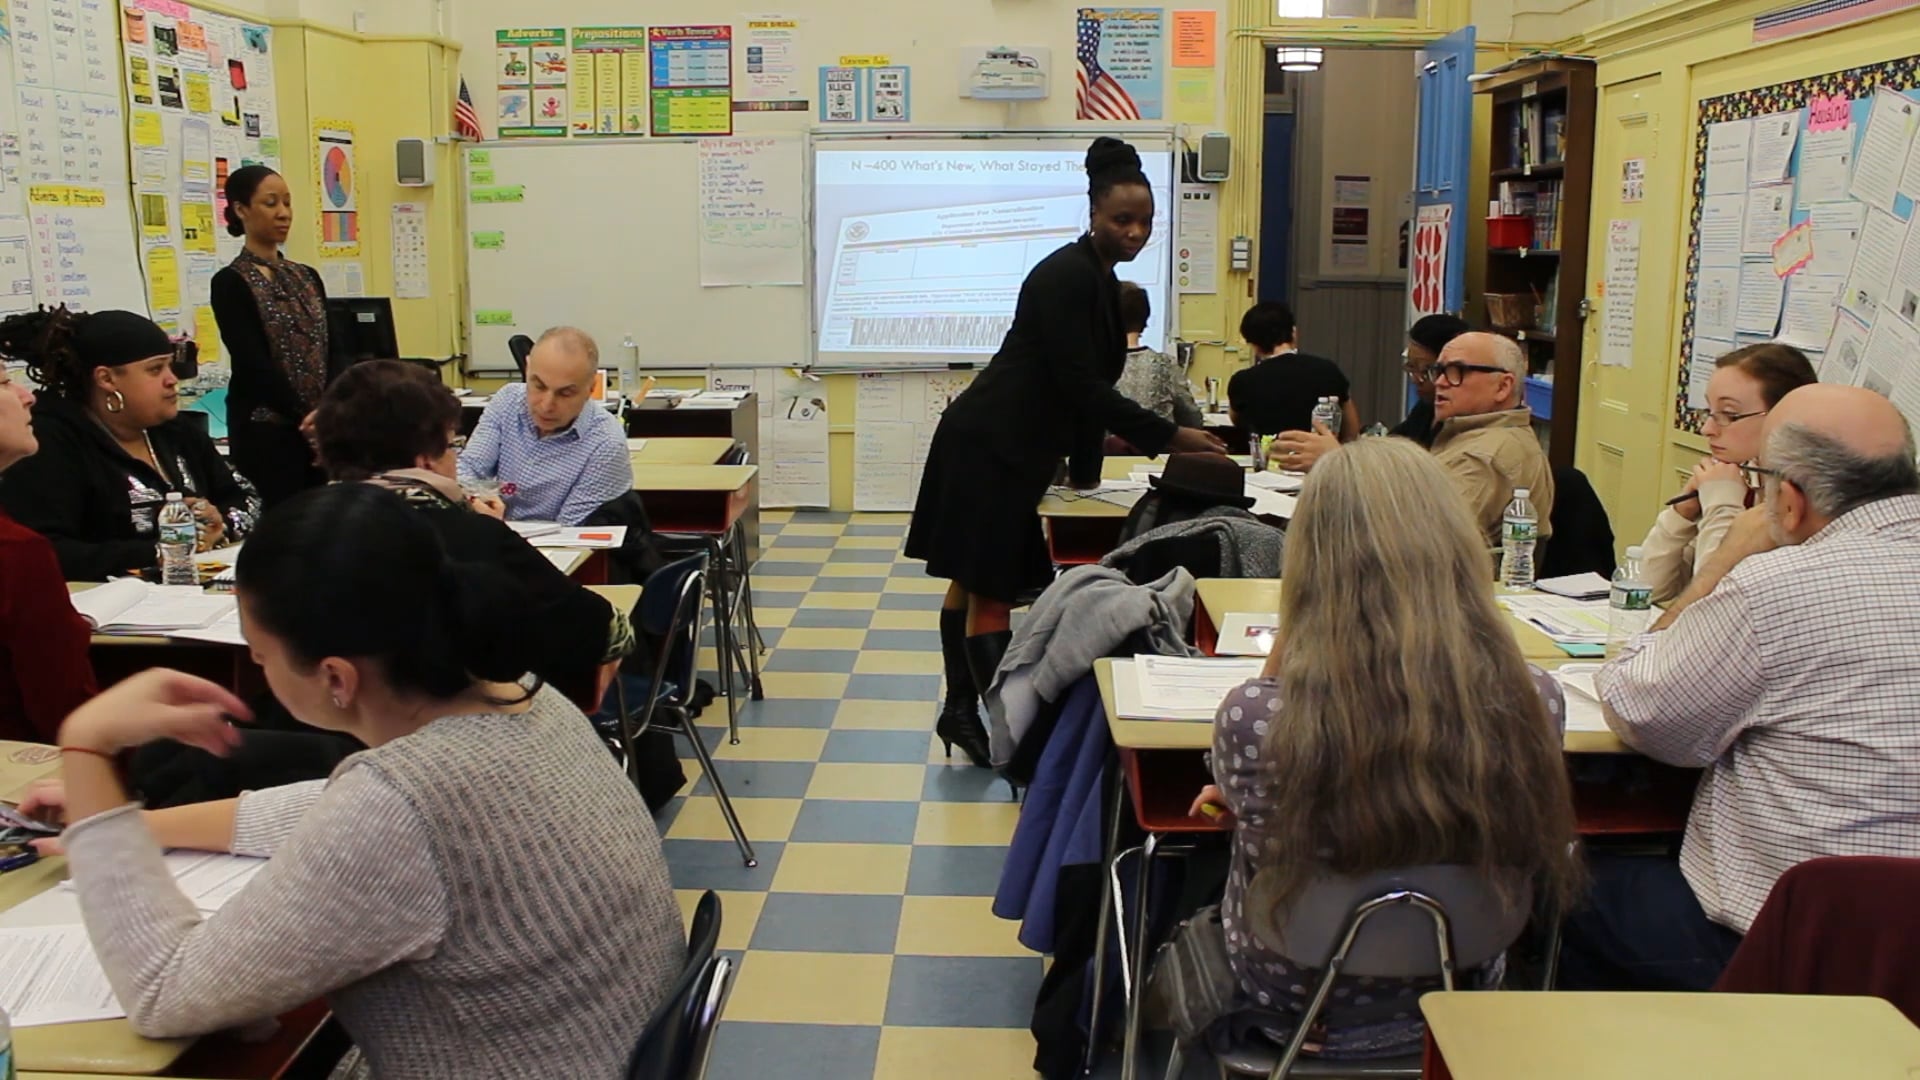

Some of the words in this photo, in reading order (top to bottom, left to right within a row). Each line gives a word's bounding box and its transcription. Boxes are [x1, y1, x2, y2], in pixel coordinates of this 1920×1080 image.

[508, 30, 554, 38] Adverbs
[572, 28, 643, 40] Prepositions
[1809, 98, 1848, 126] Housing
[851, 160, 861, 170] N
[902, 160, 942, 170] What's
[946, 160, 977, 172] New,
[980, 160, 1013, 170] What
[1018, 160, 1060, 172] Stayed
[714, 378, 752, 391] Summer
